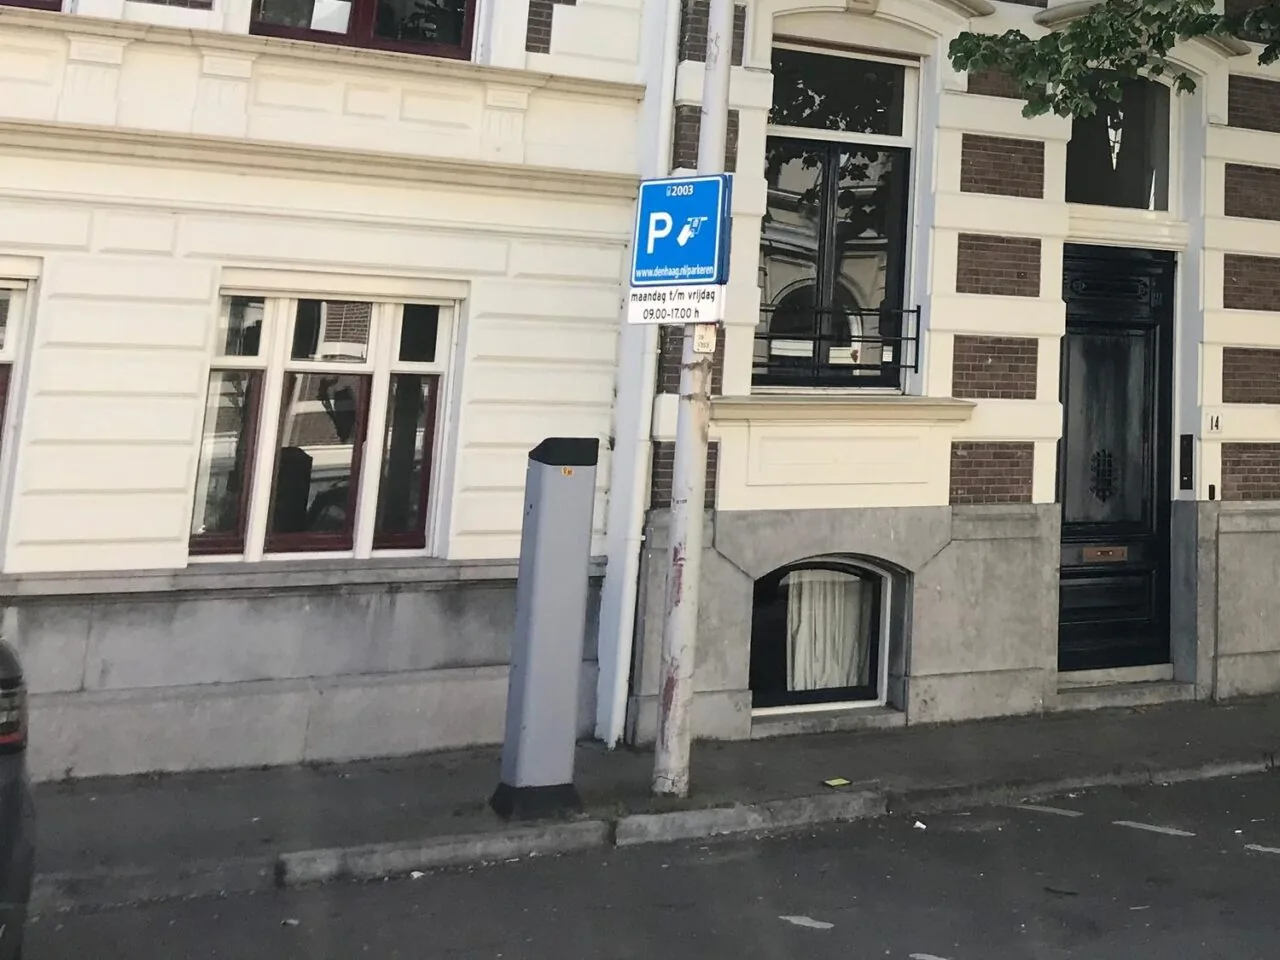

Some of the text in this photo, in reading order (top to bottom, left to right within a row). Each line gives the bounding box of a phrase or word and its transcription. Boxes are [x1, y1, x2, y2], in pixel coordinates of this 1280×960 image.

[671, 185, 694, 196] 2003
[647, 211, 673, 254] P
[631, 289, 716, 304] maandag t/m vrijdag
[643, 308, 700, 320] 09.00-17.00 h
[1210, 415, 1220, 431] 14
